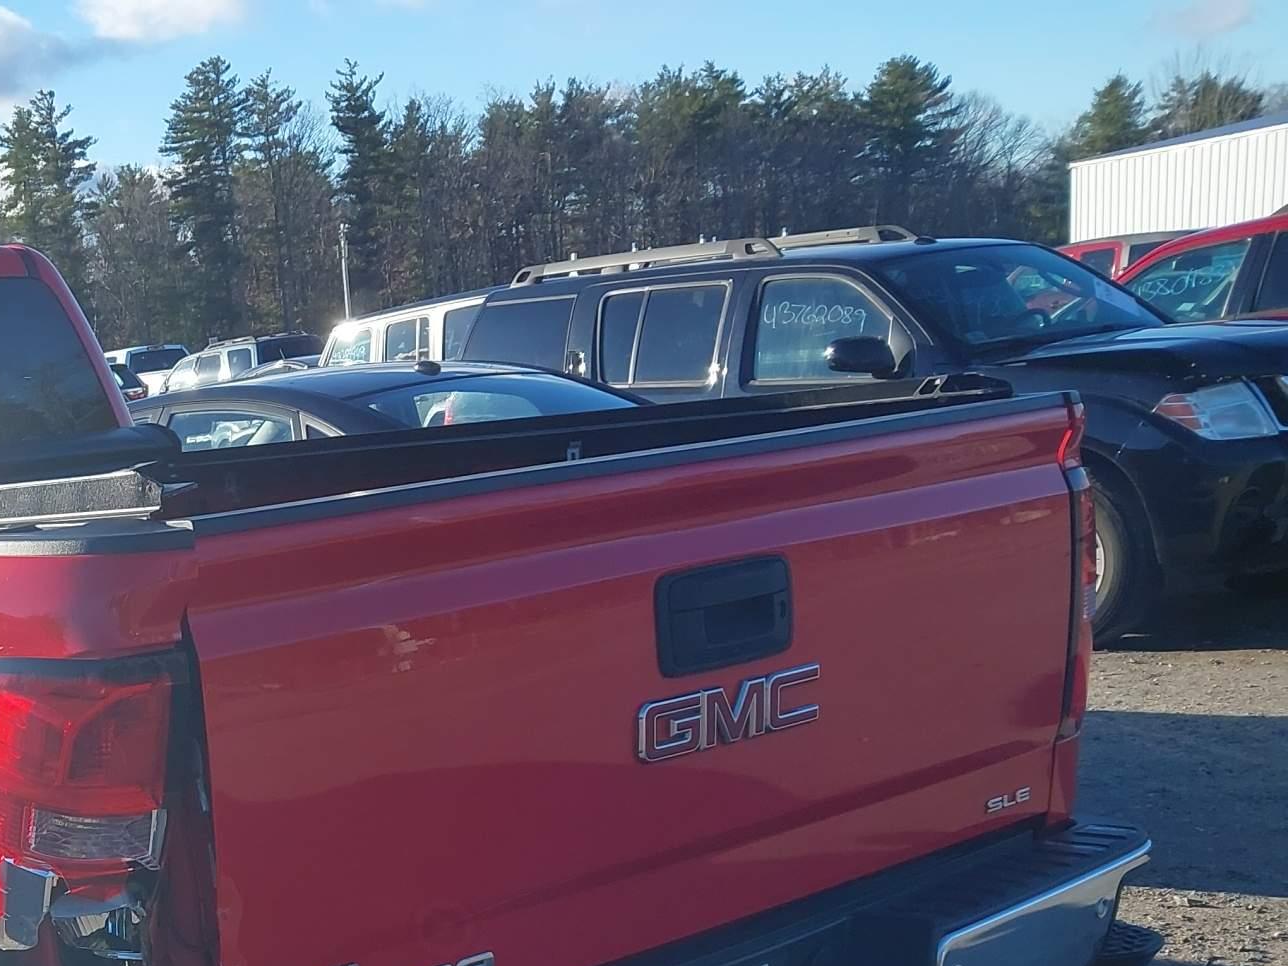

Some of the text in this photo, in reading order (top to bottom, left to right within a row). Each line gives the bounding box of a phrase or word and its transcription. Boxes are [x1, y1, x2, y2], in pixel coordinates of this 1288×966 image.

[763, 301, 867, 333] 43762089
[638, 663, 820, 762] GMC
[987, 786, 1031, 813] SLE
